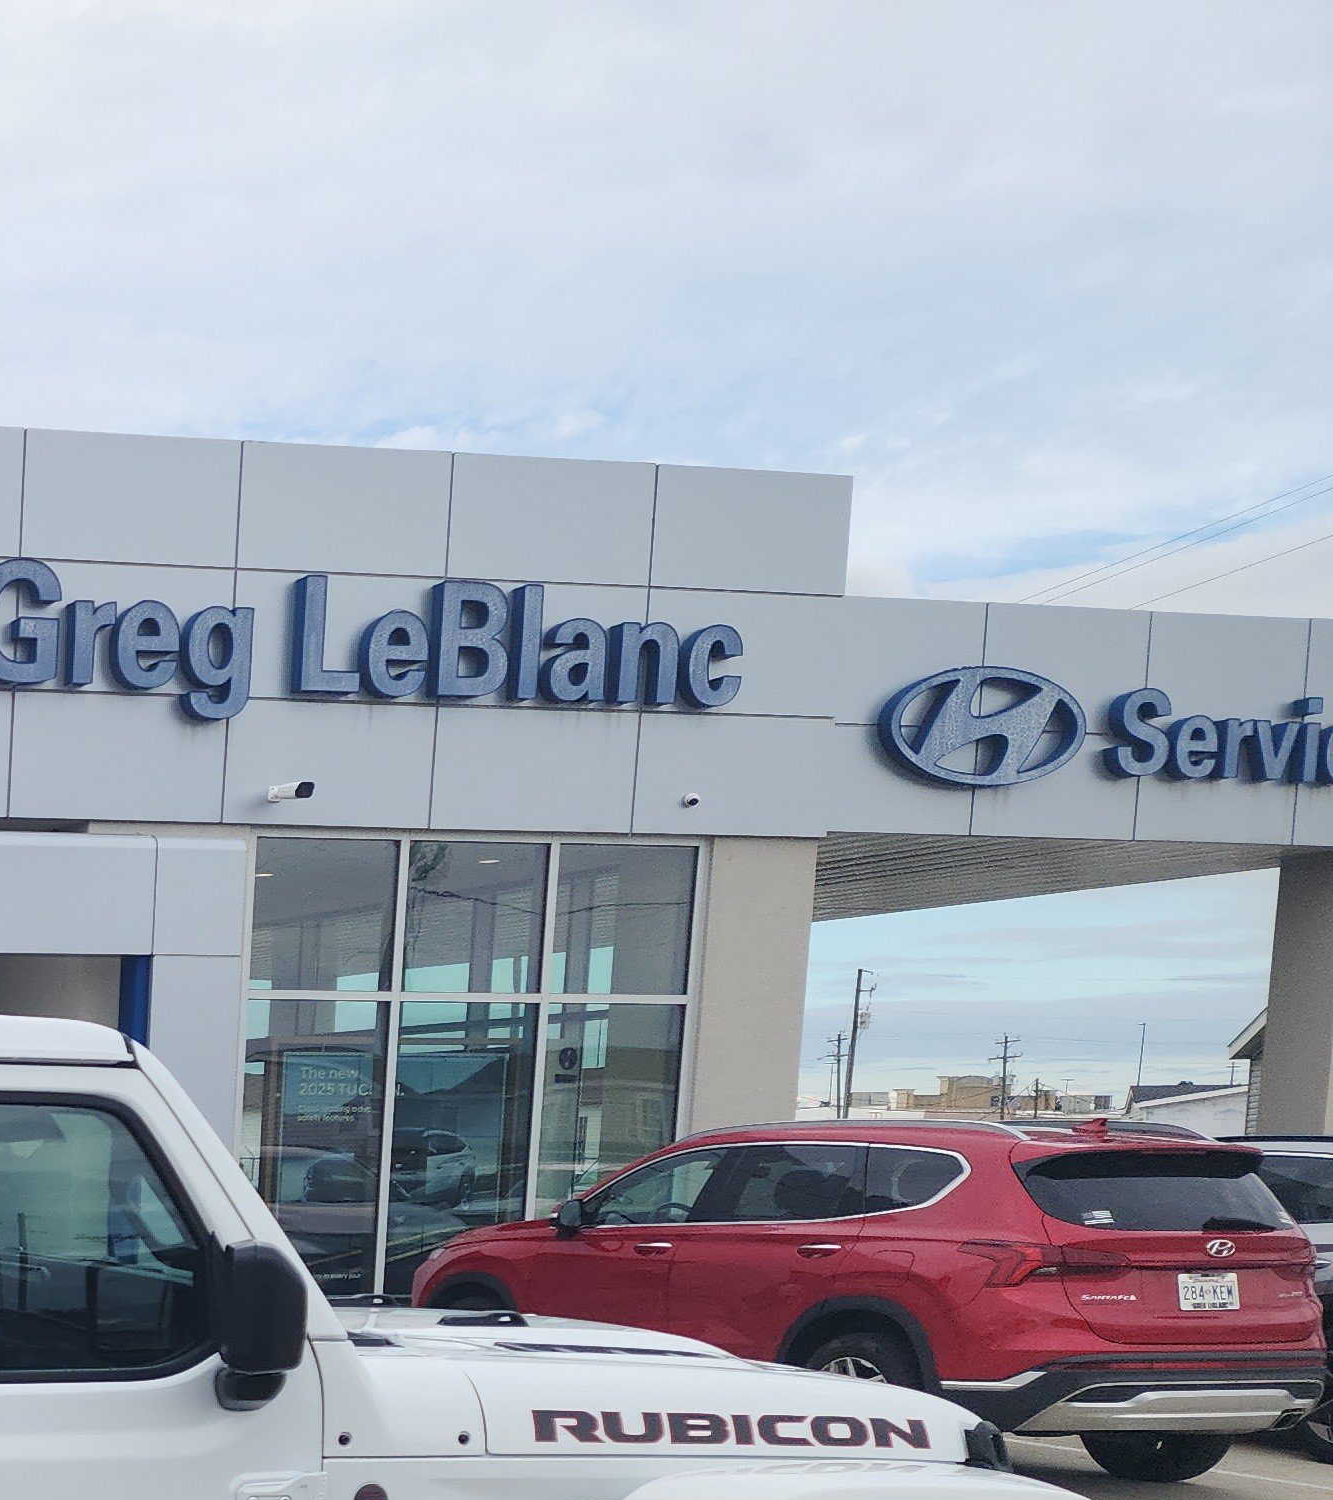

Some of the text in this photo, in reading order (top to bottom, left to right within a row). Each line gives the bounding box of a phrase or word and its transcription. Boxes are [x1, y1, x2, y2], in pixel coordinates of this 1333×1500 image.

[290, 574, 745, 709] LeBlanc
[300, 1066, 326, 1079] The
[299, 1083, 335, 1096] 2025
[1183, 1285, 1205, 1301] 284
[532, 1409, 932, 1450] RUBICON
